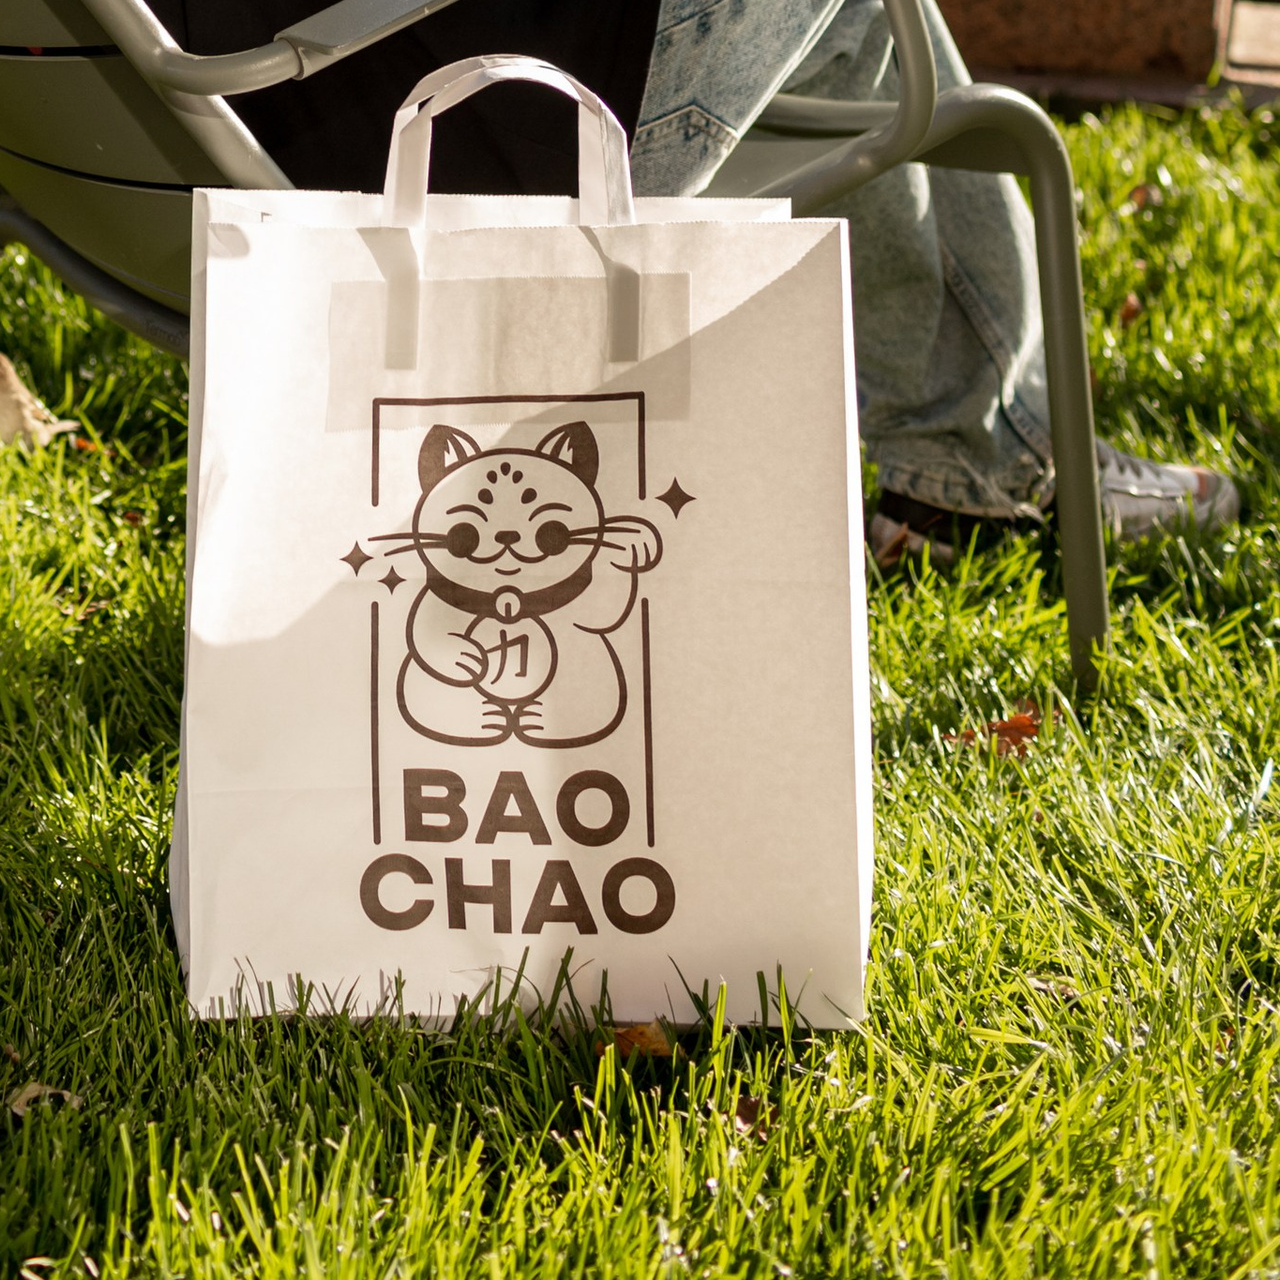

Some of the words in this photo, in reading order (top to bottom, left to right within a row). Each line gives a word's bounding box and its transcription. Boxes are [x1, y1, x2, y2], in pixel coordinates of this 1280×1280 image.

[487, 629, 529, 685] 力
[403, 769, 630, 847] BAO
[360, 854, 675, 935] CHAO
